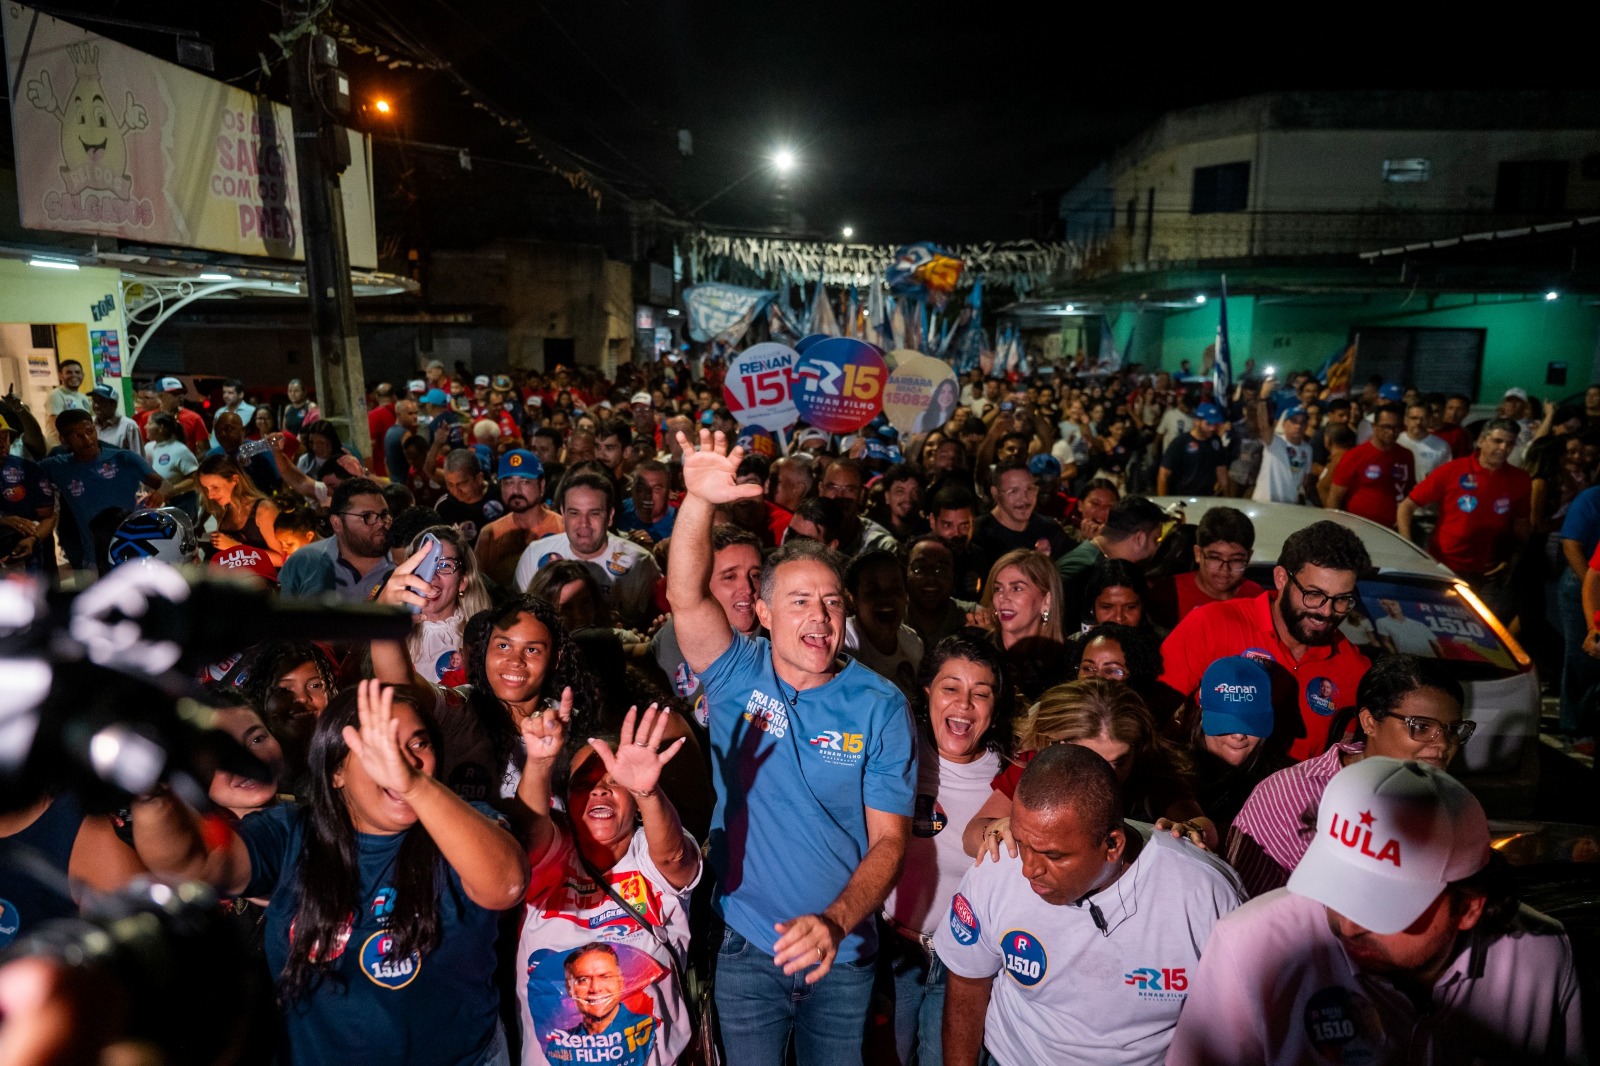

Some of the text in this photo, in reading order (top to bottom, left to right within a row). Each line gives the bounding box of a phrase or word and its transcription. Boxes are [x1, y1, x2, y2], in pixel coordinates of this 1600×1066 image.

[221, 109, 246, 133] OS
[211, 174, 252, 199] COM
[44, 190, 154, 227] SALGADOS
[739, 354, 792, 375] RENAN
[802, 394, 875, 411] RENAN FILHO
[219, 549, 262, 566] LULA
[228, 558, 257, 569] 2026
[1425, 615, 1485, 638] 1510
[750, 689, 769, 707] PRA
[1214, 683, 1257, 694] Renan
[1223, 693, 1254, 702] FILHO
[819, 749, 842, 757] RENAN
[932, 821, 943, 831] 15
[1329, 812, 1402, 868] LULA
[950, 916, 973, 943] 5577
[1017, 937, 1027, 951] R
[371, 958, 413, 979] 1510
[1007, 953, 1041, 979] 1510
[545, 1028, 622, 1049] Renan
[1312, 1019, 1355, 1041] 1510
[575, 1045, 624, 1063] FILHO
